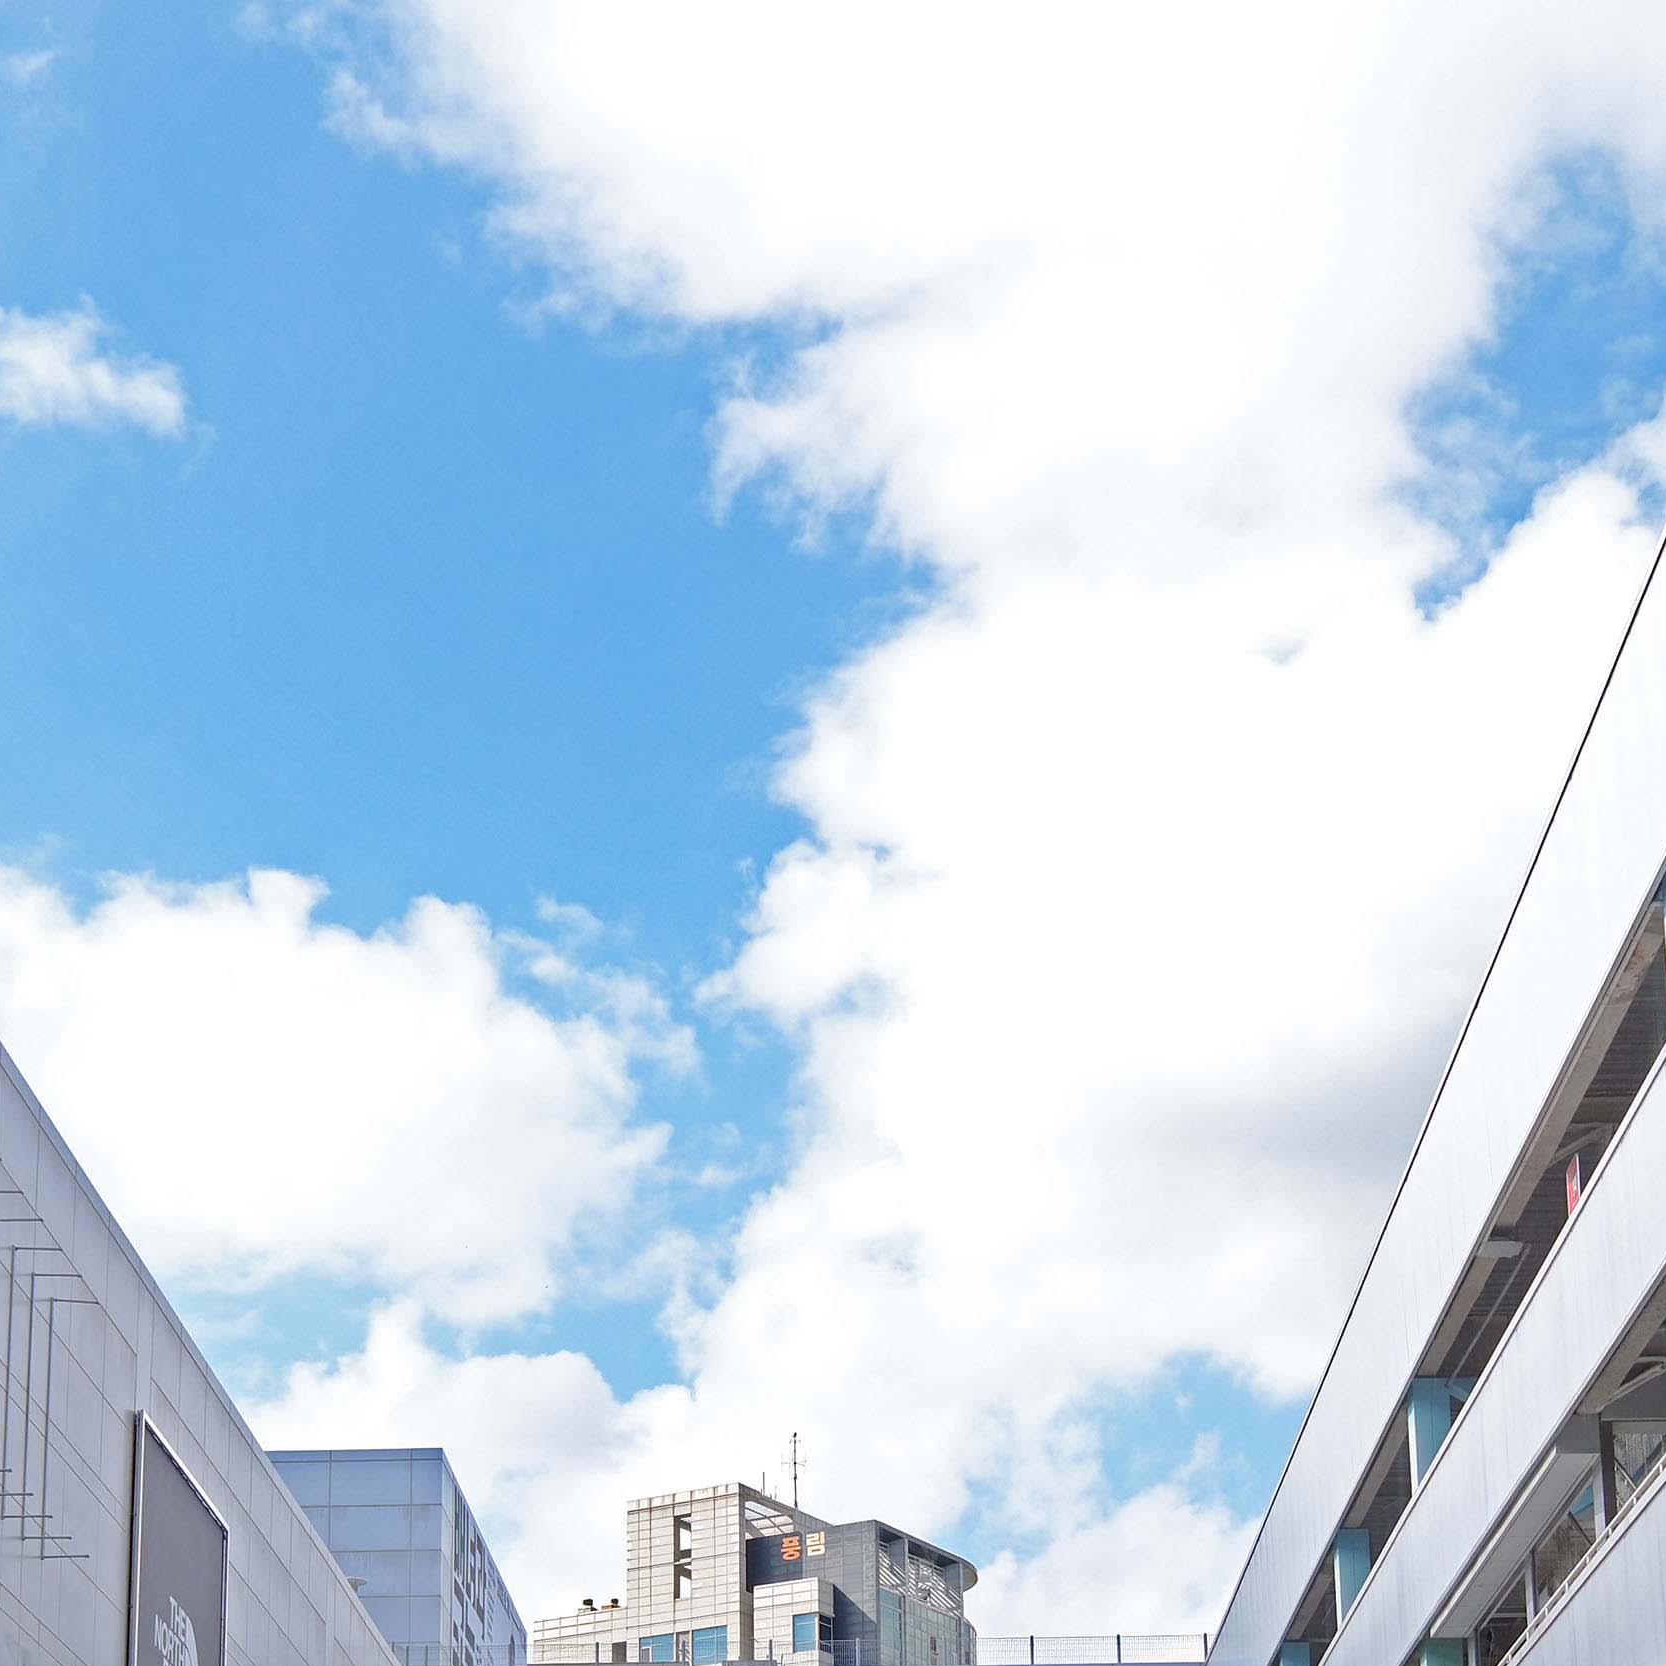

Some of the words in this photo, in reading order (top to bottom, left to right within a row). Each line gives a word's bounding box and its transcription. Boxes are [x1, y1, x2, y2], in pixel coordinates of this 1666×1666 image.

[781, 1531, 824, 1560] 풍림
[169, 1596, 187, 1632] THE
[154, 1614, 187, 1666] NORTH
